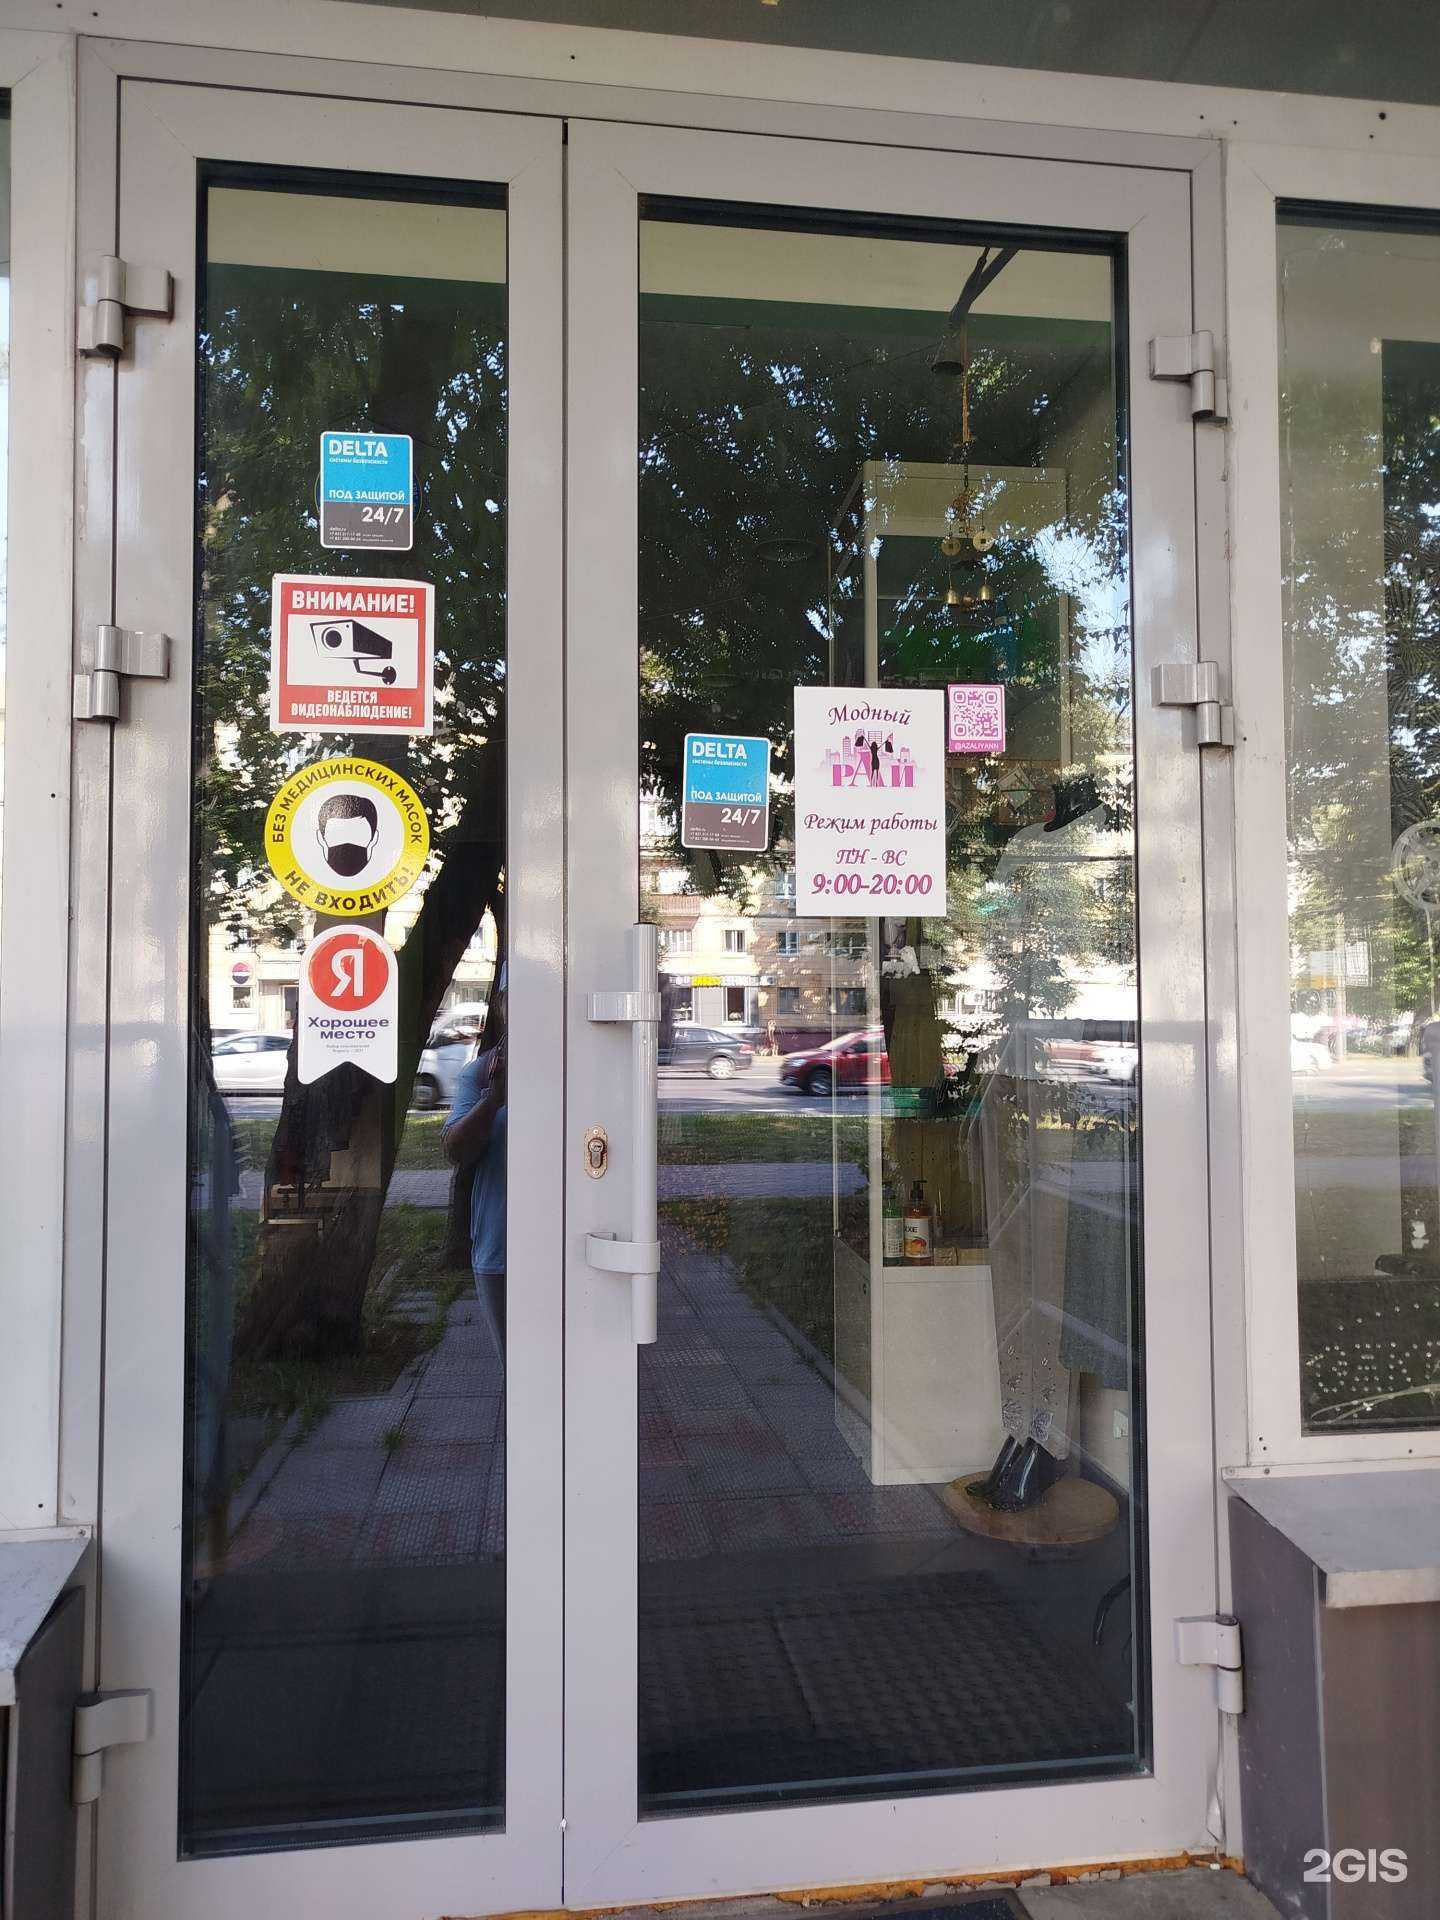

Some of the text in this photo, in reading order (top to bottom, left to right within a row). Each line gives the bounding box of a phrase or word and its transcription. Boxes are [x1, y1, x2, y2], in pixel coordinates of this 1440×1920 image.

[329, 440, 388, 457] DELTA
[329, 490, 405, 501] ПОД ЗАЩИТОЙ
[362, 507, 404, 525] 24/7
[292, 590, 415, 613] ВНИМАНИЕ!
[327, 690, 377, 704] ВЕДЕТСЯ
[291, 704, 412, 720] ВИДЕОНАБЛЮДЕНИЕ!
[828, 701, 912, 726] Модный
[692, 741, 747, 759] DELTA
[273, 764, 422, 844] БЕЗ МЕДИЦИНСКИХ МАСОК
[691, 791, 761, 802] ПОД ЗАЩИТОЙ
[721, 808, 760, 826] 24/7
[804, 813, 938, 835] Режим работы
[835, 848, 869, 865] ПН
[881, 849, 908, 866] ВС
[285, 870, 312, 896] НЕ
[811, 873, 932, 895] 9:00-20:00
[330, 948, 363, 997] Я
[308, 1017, 389, 1030] Хорошее
[320, 1030, 376, 1039] место
